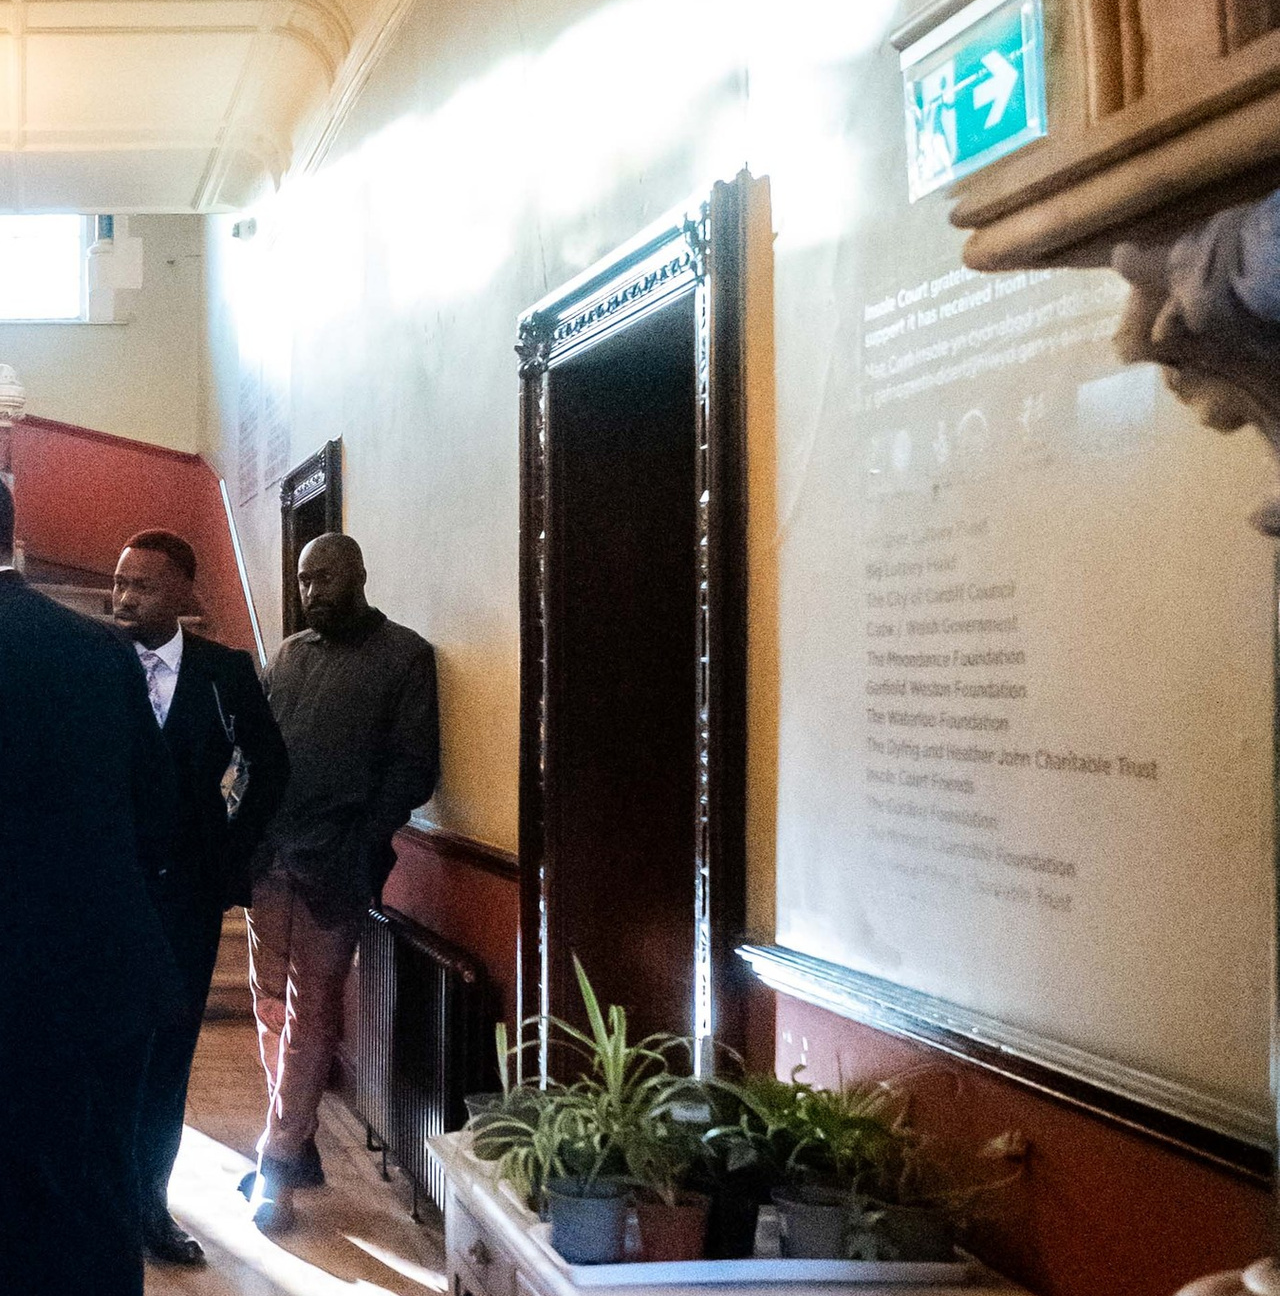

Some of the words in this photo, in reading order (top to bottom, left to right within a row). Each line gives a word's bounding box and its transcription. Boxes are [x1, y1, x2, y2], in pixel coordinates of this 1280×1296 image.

[897, 281, 928, 308] Court
[907, 313, 916, 332] it
[917, 307, 938, 329] has
[940, 281, 992, 318] received
[994, 273, 1028, 299] from
[886, 589, 908, 609] City
[967, 579, 1017, 601] Council
[941, 614, 1018, 634] Government
[952, 648, 1026, 667] Foundation
[953, 679, 1028, 699] Foundation
[939, 711, 1010, 732] Foundation
[922, 744, 945, 760] and
[946, 743, 995, 763] Heather
[997, 746, 1031, 766] John
[1034, 748, 1112, 776] Charitable
[1116, 755, 1159, 782] Trust
[995, 846, 1077, 878] Foundation
